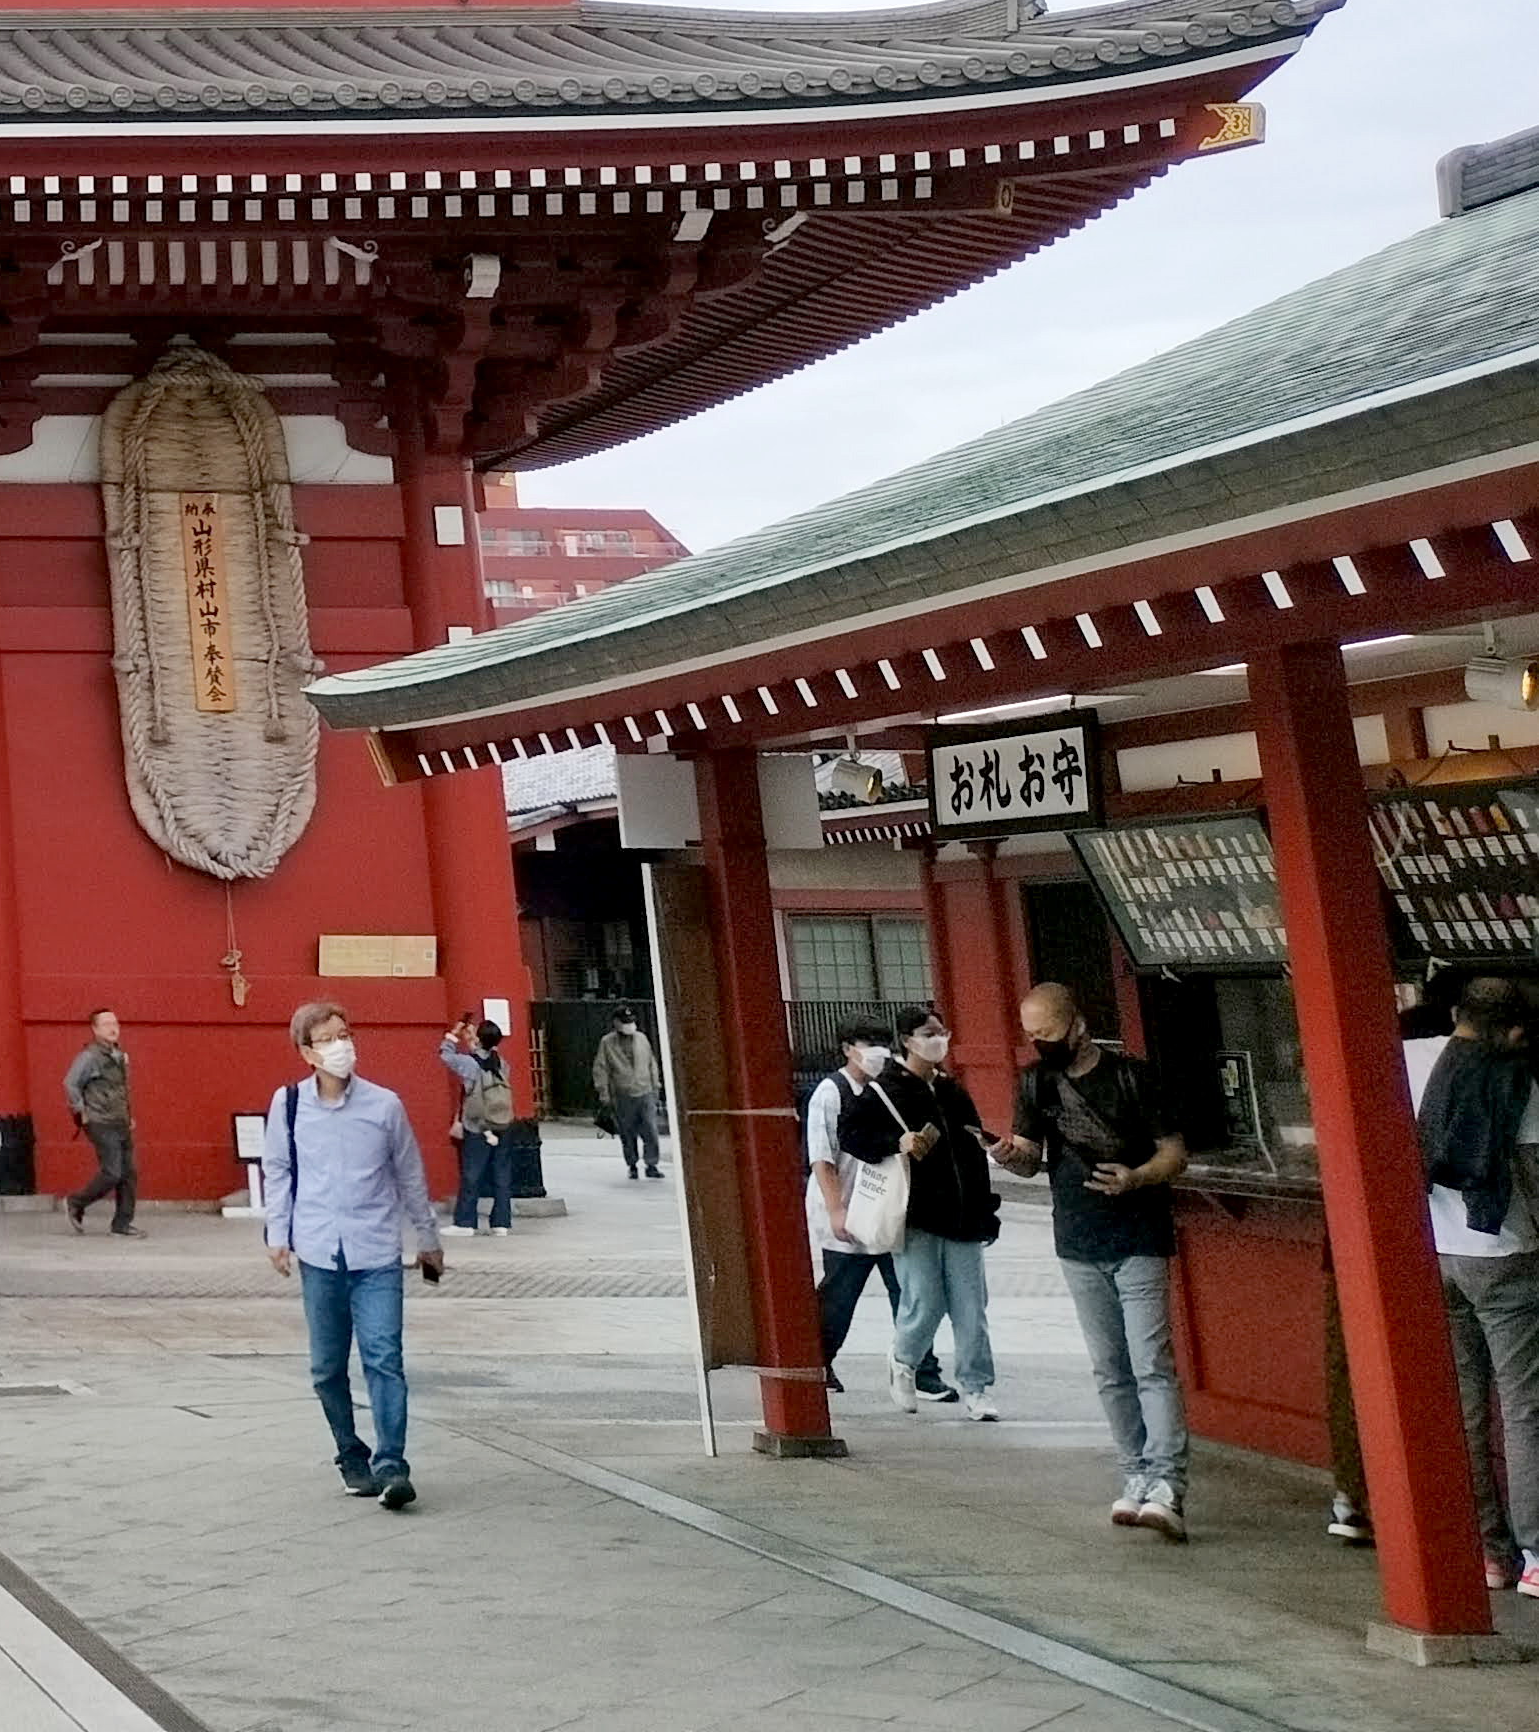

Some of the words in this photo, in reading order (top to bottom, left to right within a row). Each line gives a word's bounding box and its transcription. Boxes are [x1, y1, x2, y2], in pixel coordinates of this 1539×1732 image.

[191, 518, 227, 703] 山形県村山市奉賛会
[949, 737, 1082, 816] お札お守
